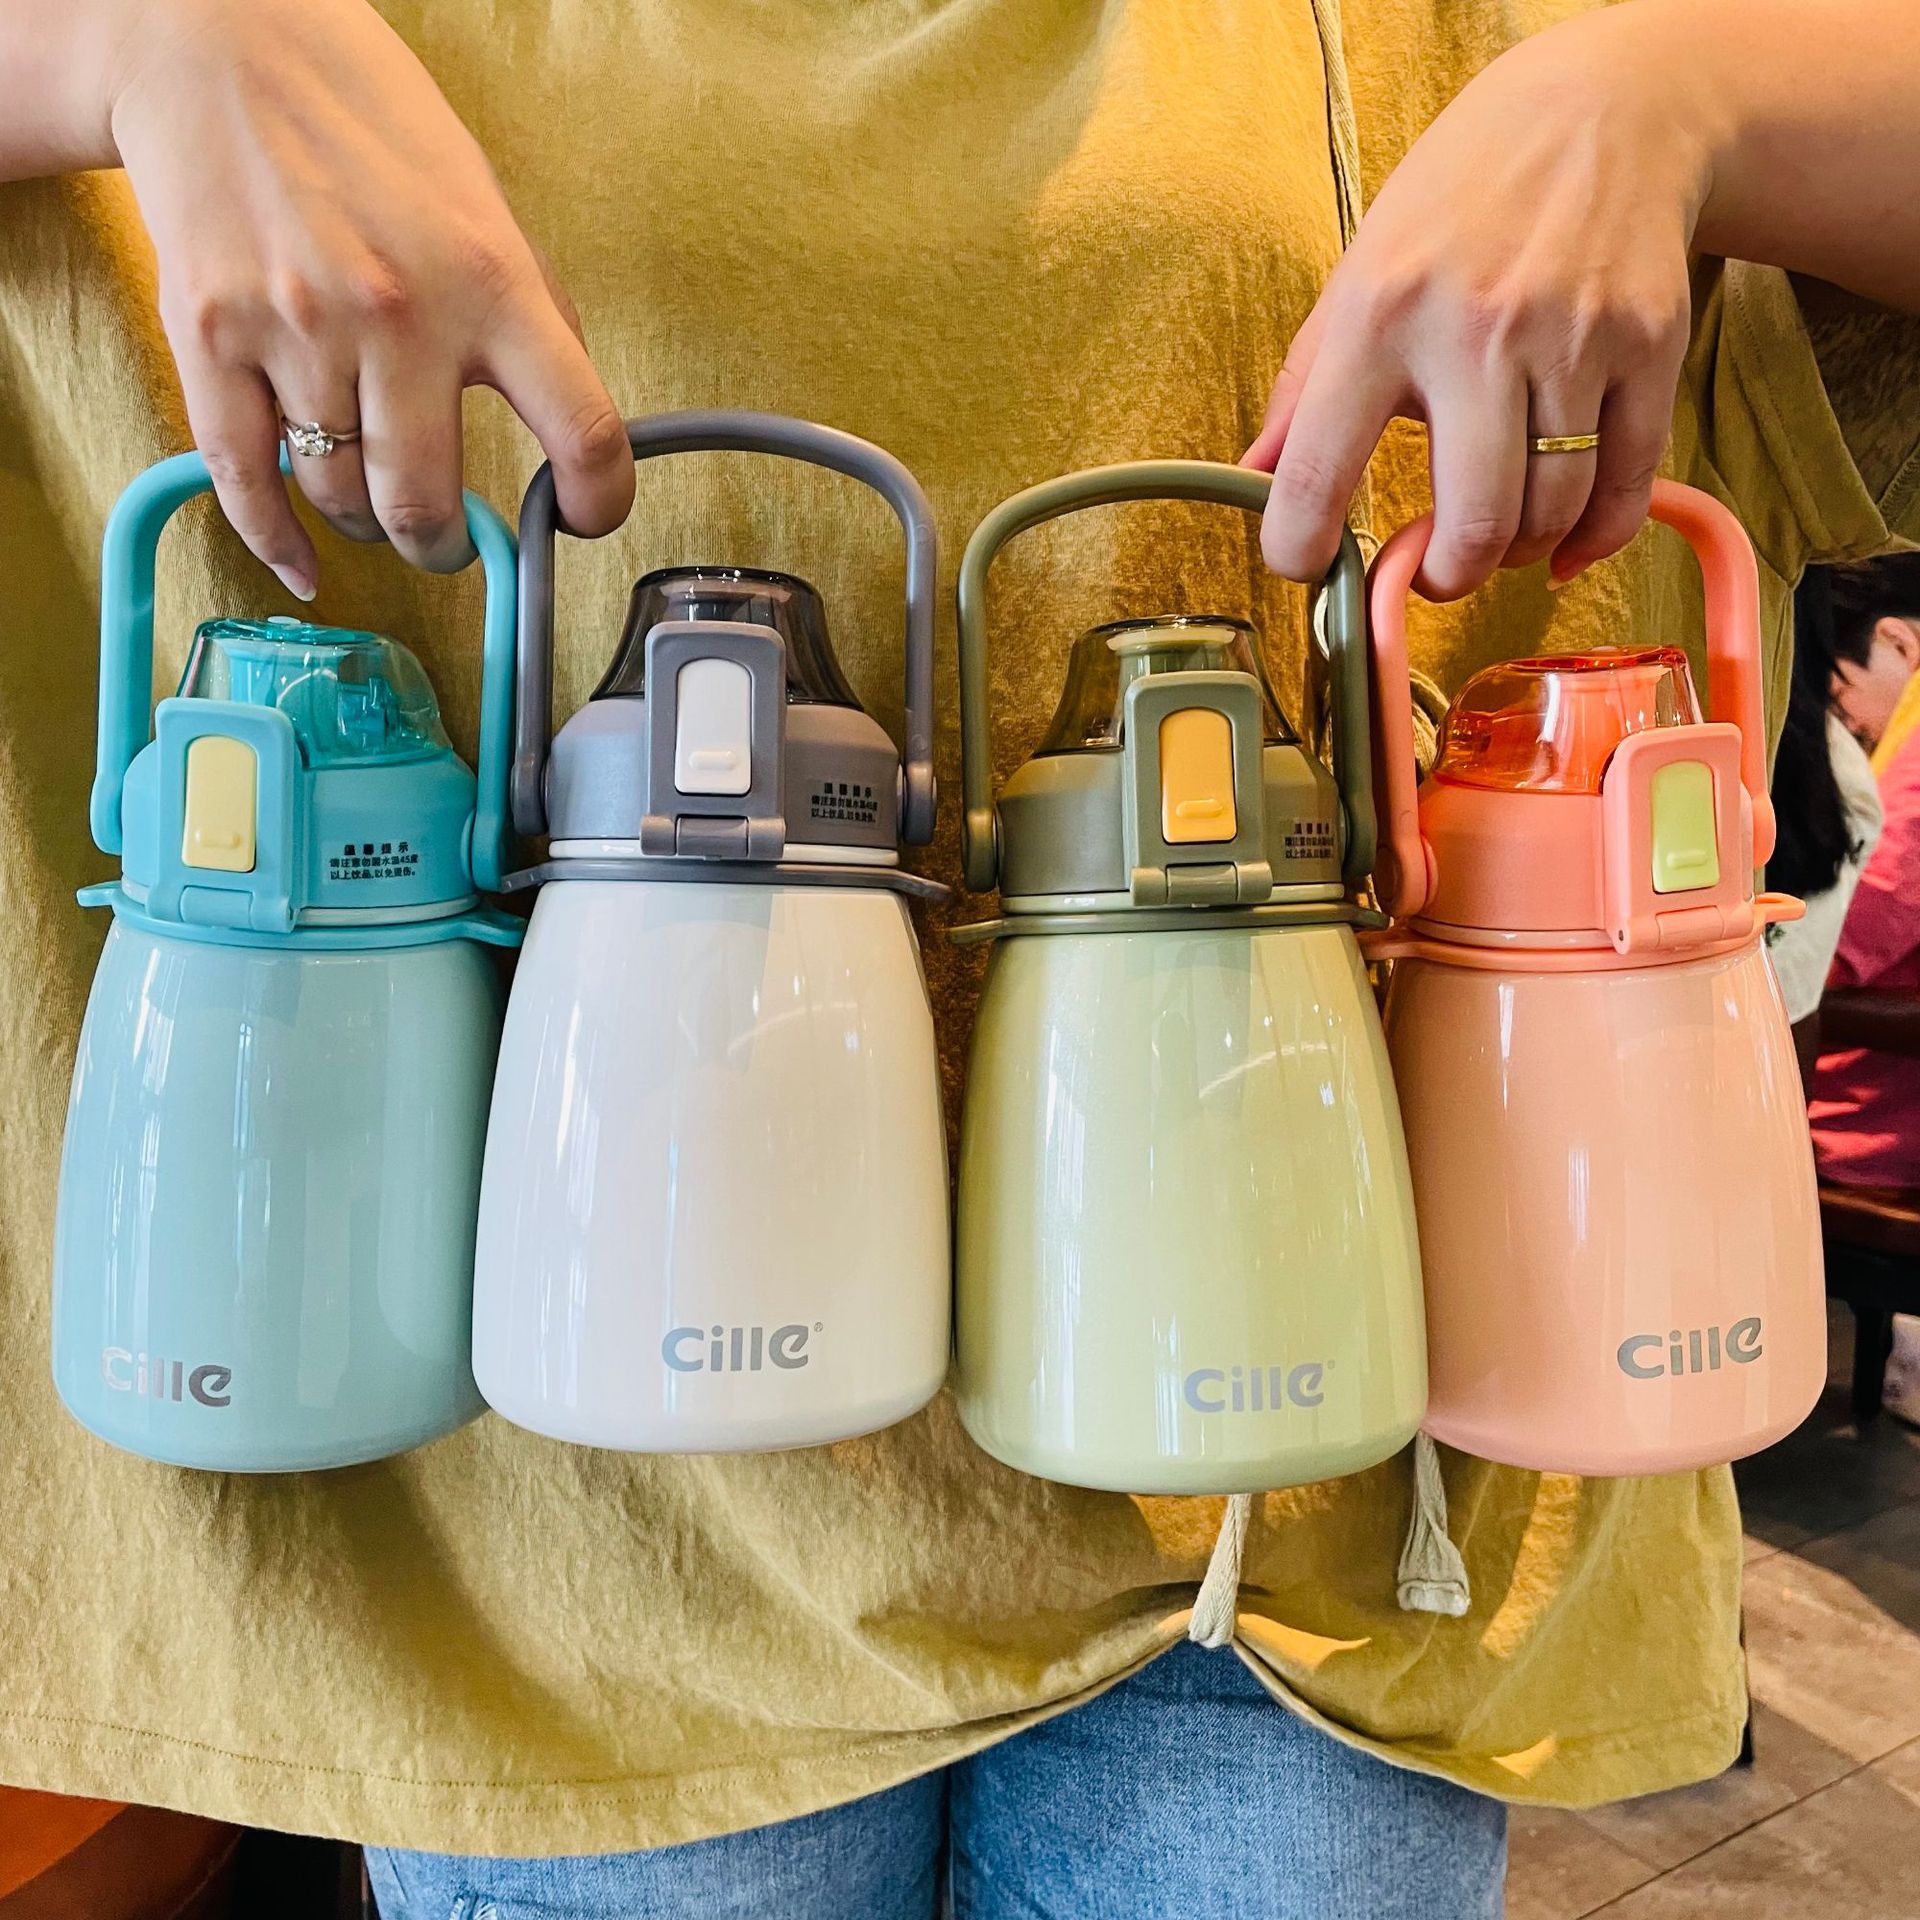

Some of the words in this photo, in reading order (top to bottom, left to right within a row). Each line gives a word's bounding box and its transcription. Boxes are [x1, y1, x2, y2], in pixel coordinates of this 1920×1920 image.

[661, 1325, 809, 1372] Cille
[1617, 1317, 1763, 1379] Cille
[102, 1346, 232, 1407] Cille
[1184, 1363, 1324, 1413] Cille
